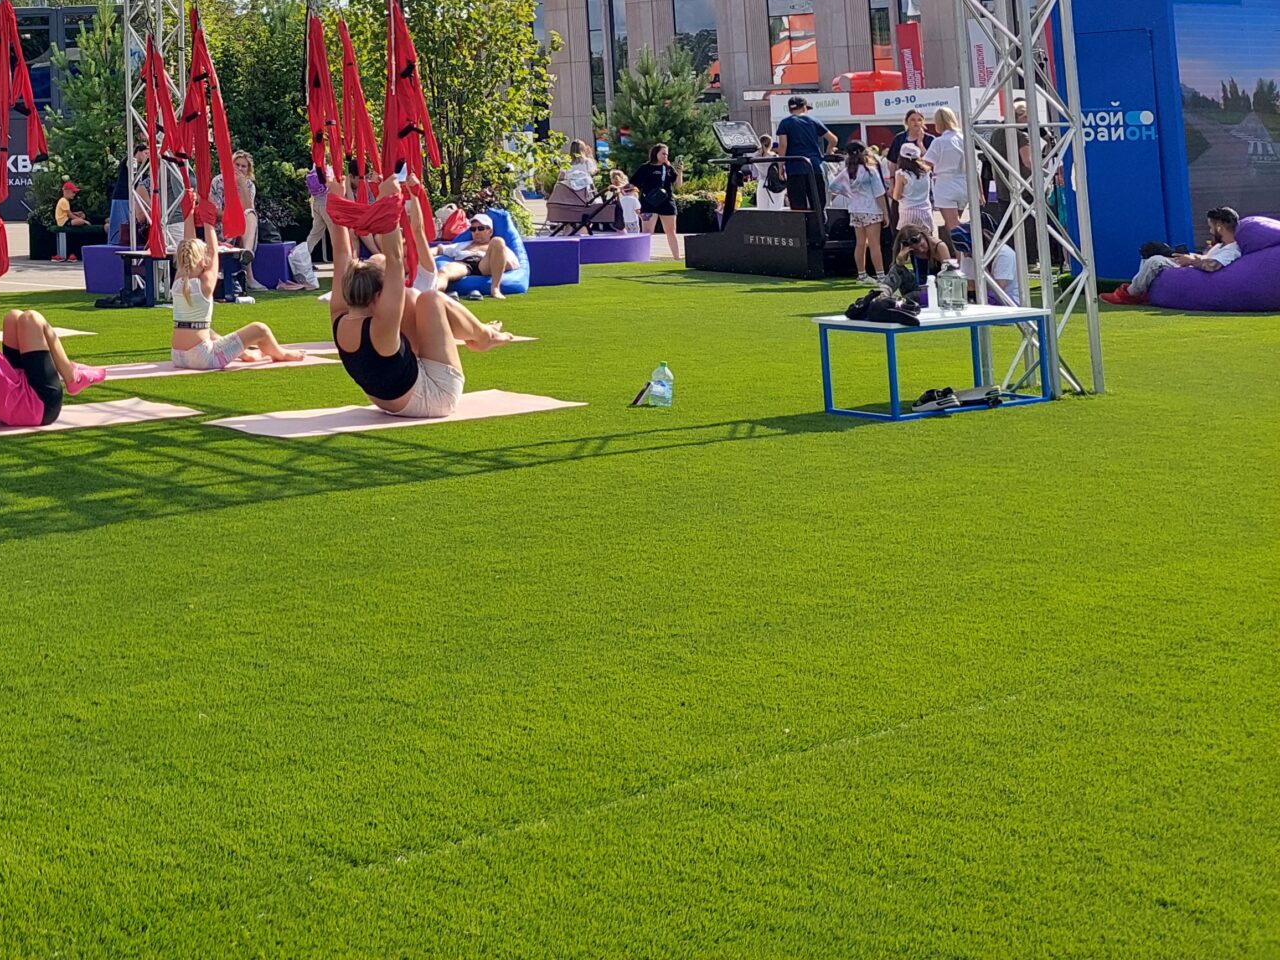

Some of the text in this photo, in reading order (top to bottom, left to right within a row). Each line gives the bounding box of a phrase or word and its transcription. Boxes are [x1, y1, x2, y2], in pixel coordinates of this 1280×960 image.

[815, 97, 840, 109] ОНЛАЙН
[884, 95, 917, 107] 8-9-10
[915, 100, 949, 108] сентября
[749, 235, 794, 246] FITNESS
